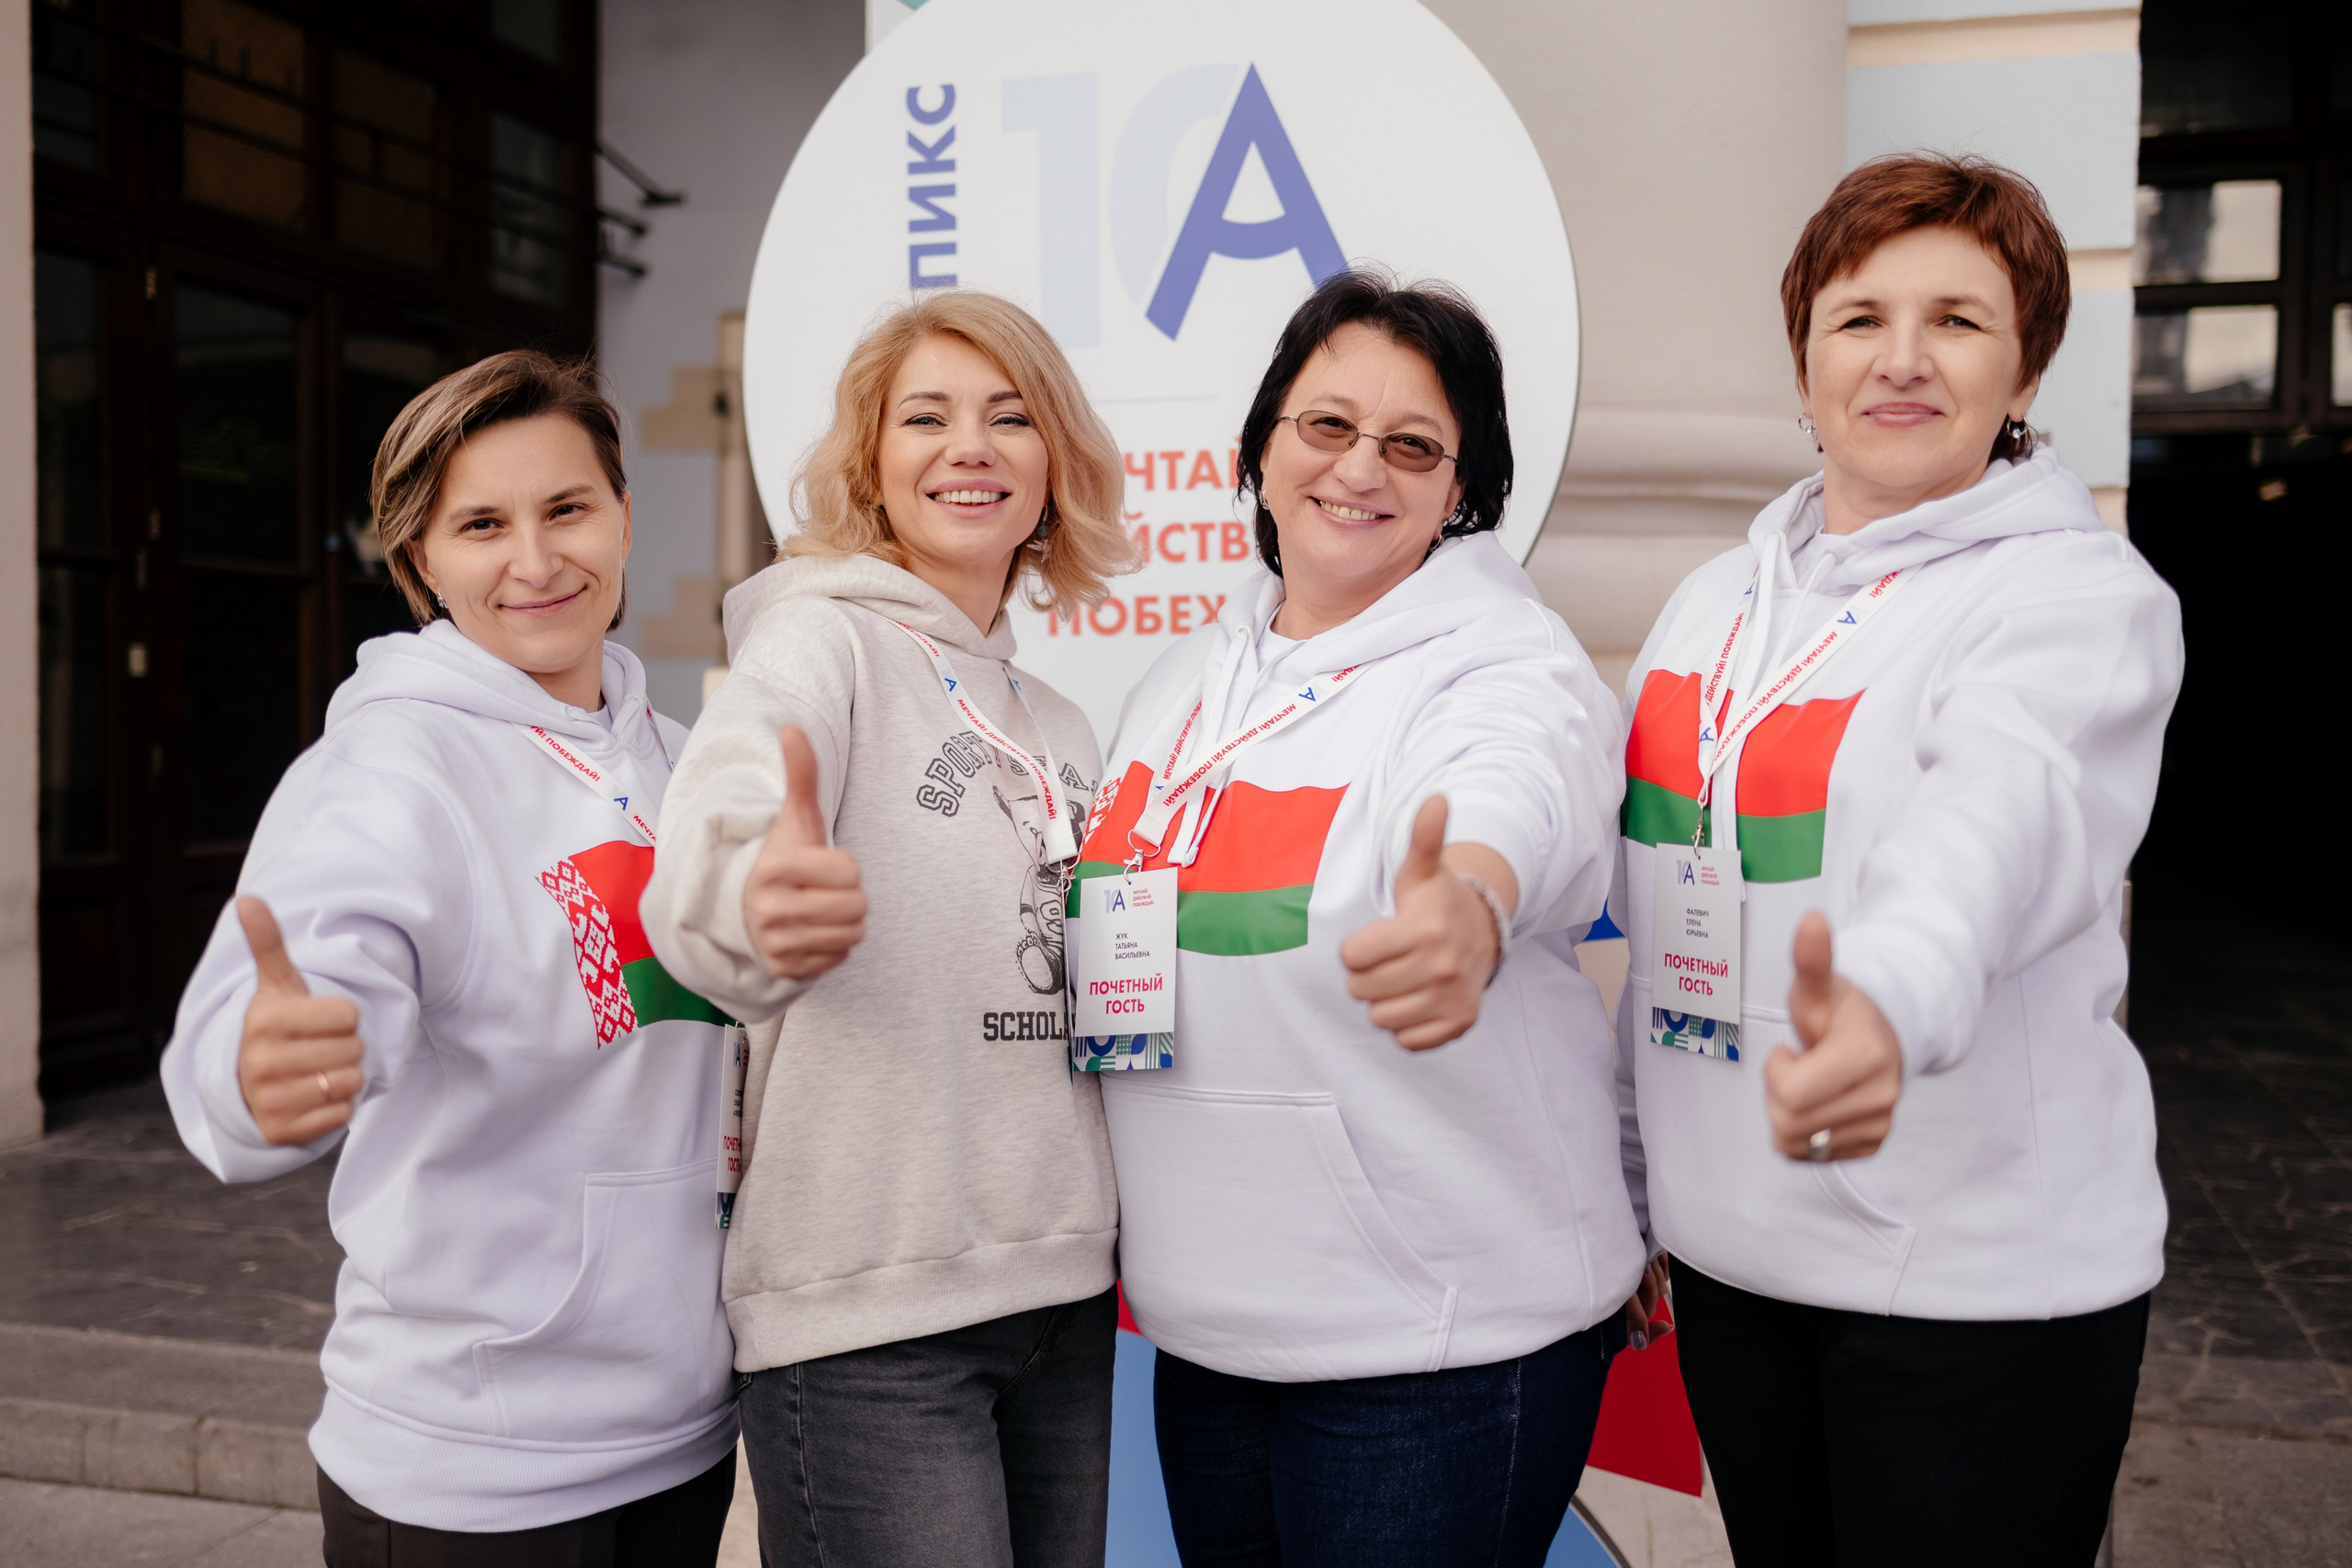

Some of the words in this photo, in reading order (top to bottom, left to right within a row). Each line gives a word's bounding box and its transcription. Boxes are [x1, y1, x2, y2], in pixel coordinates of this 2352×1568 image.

[906, 84, 957, 288] ПИКС
[1123, 435, 1242, 491] ЧТА
[1048, 593, 1227, 637] ПОБЕЖ
[1705, 660, 1727, 704] ДЕЙСТВУЙ!
[1721, 612, 1745, 659] ПОБЕЖДАЙ!
[1801, 631, 1838, 667] МЕЧТАЙ!
[1757, 664, 1804, 706] ДЕЙСТВУЙ!
[1258, 704, 1296, 731] МЕЧТАЙ!
[957, 699, 988, 732] МЕЧТАЙ!
[985, 731, 1030, 763] ДЕЙСТВУЙ!
[1029, 762, 1057, 820] ПОБЕЖДАЙ!
[1163, 752, 1179, 780] МЕЧТАЙ!
[1173, 718, 1193, 755] ДЕЙСТВУЙ!
[1211, 728, 1259, 762] ДЕЙСТВУЙ!
[546, 738, 601, 782] ПОБЕЖДАЙ!
[633, 815, 657, 842] МЕЧТА
[916, 730, 1001, 818] SPORT
[1163, 761, 1213, 807] ПОБЕЖДАЙ!
[1115, 932, 1128, 941] ЖУК
[1685, 929, 1709, 938] ЮРЬЕВНА
[1686, 919, 1702, 927] ЕЛЕНА
[1114, 950, 1150, 960] ВАСИЛЬЕВНА
[1115, 942, 1138, 950] ТАТЬЯНА
[1664, 953, 1728, 978] ПОЧЕТНЫЙ
[1090, 972, 1163, 996] ПОЧЕТНЫЙ
[1679, 976, 1713, 996] ГОСТЬ
[1106, 998, 1146, 1014] ГОСТЬ
